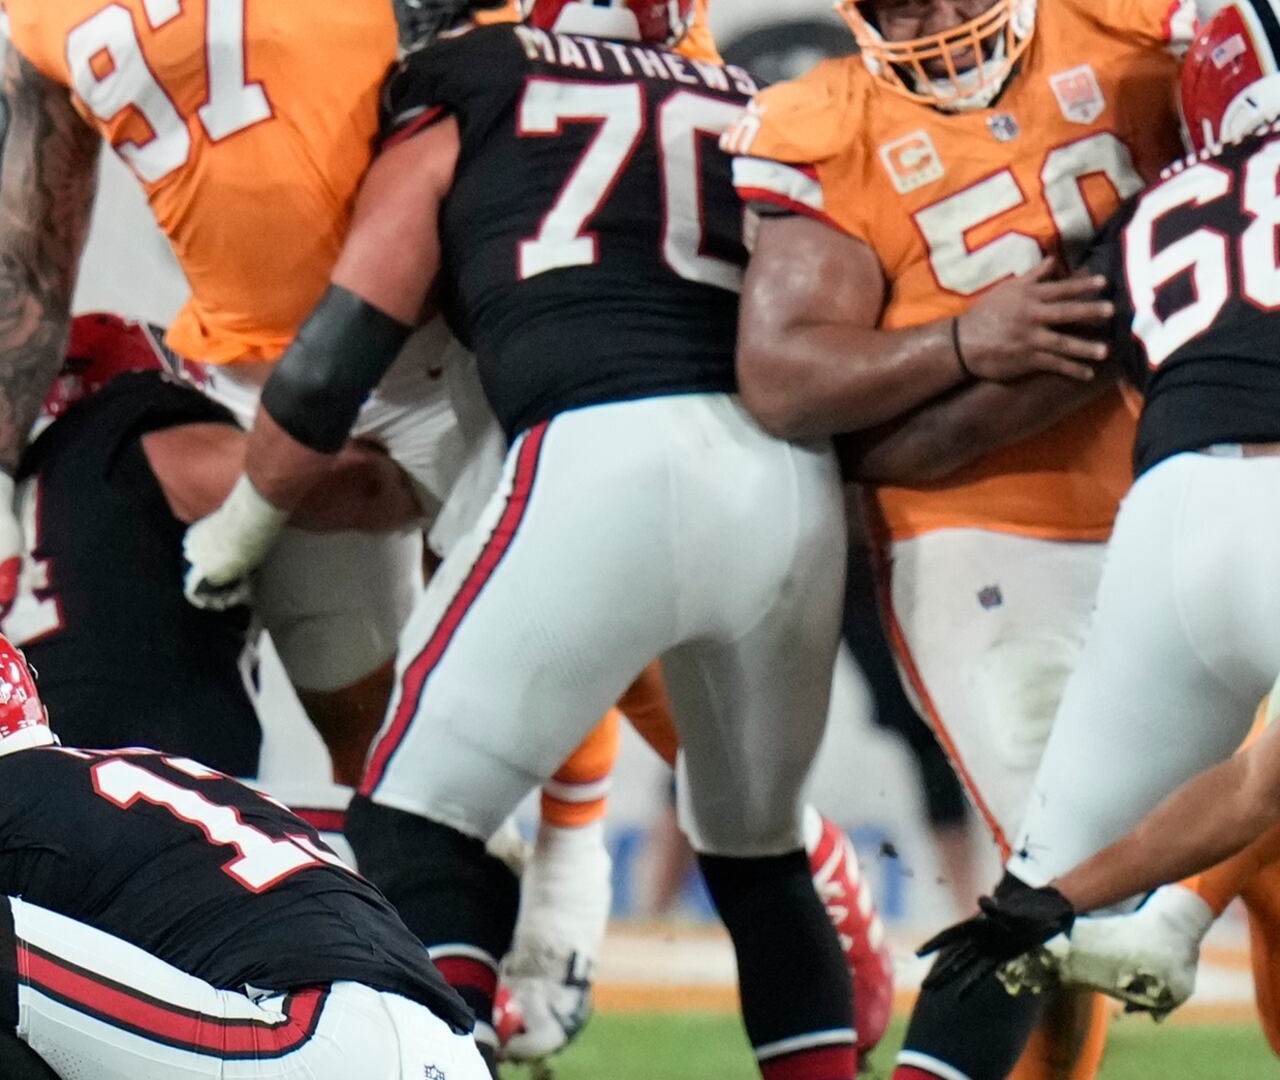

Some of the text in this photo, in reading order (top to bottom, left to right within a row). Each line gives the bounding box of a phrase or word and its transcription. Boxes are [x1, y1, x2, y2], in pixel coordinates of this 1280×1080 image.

[513, 24, 760, 95] MATTHEWS
[515, 75, 748, 293] 70
[888, 138, 933, 177] C
